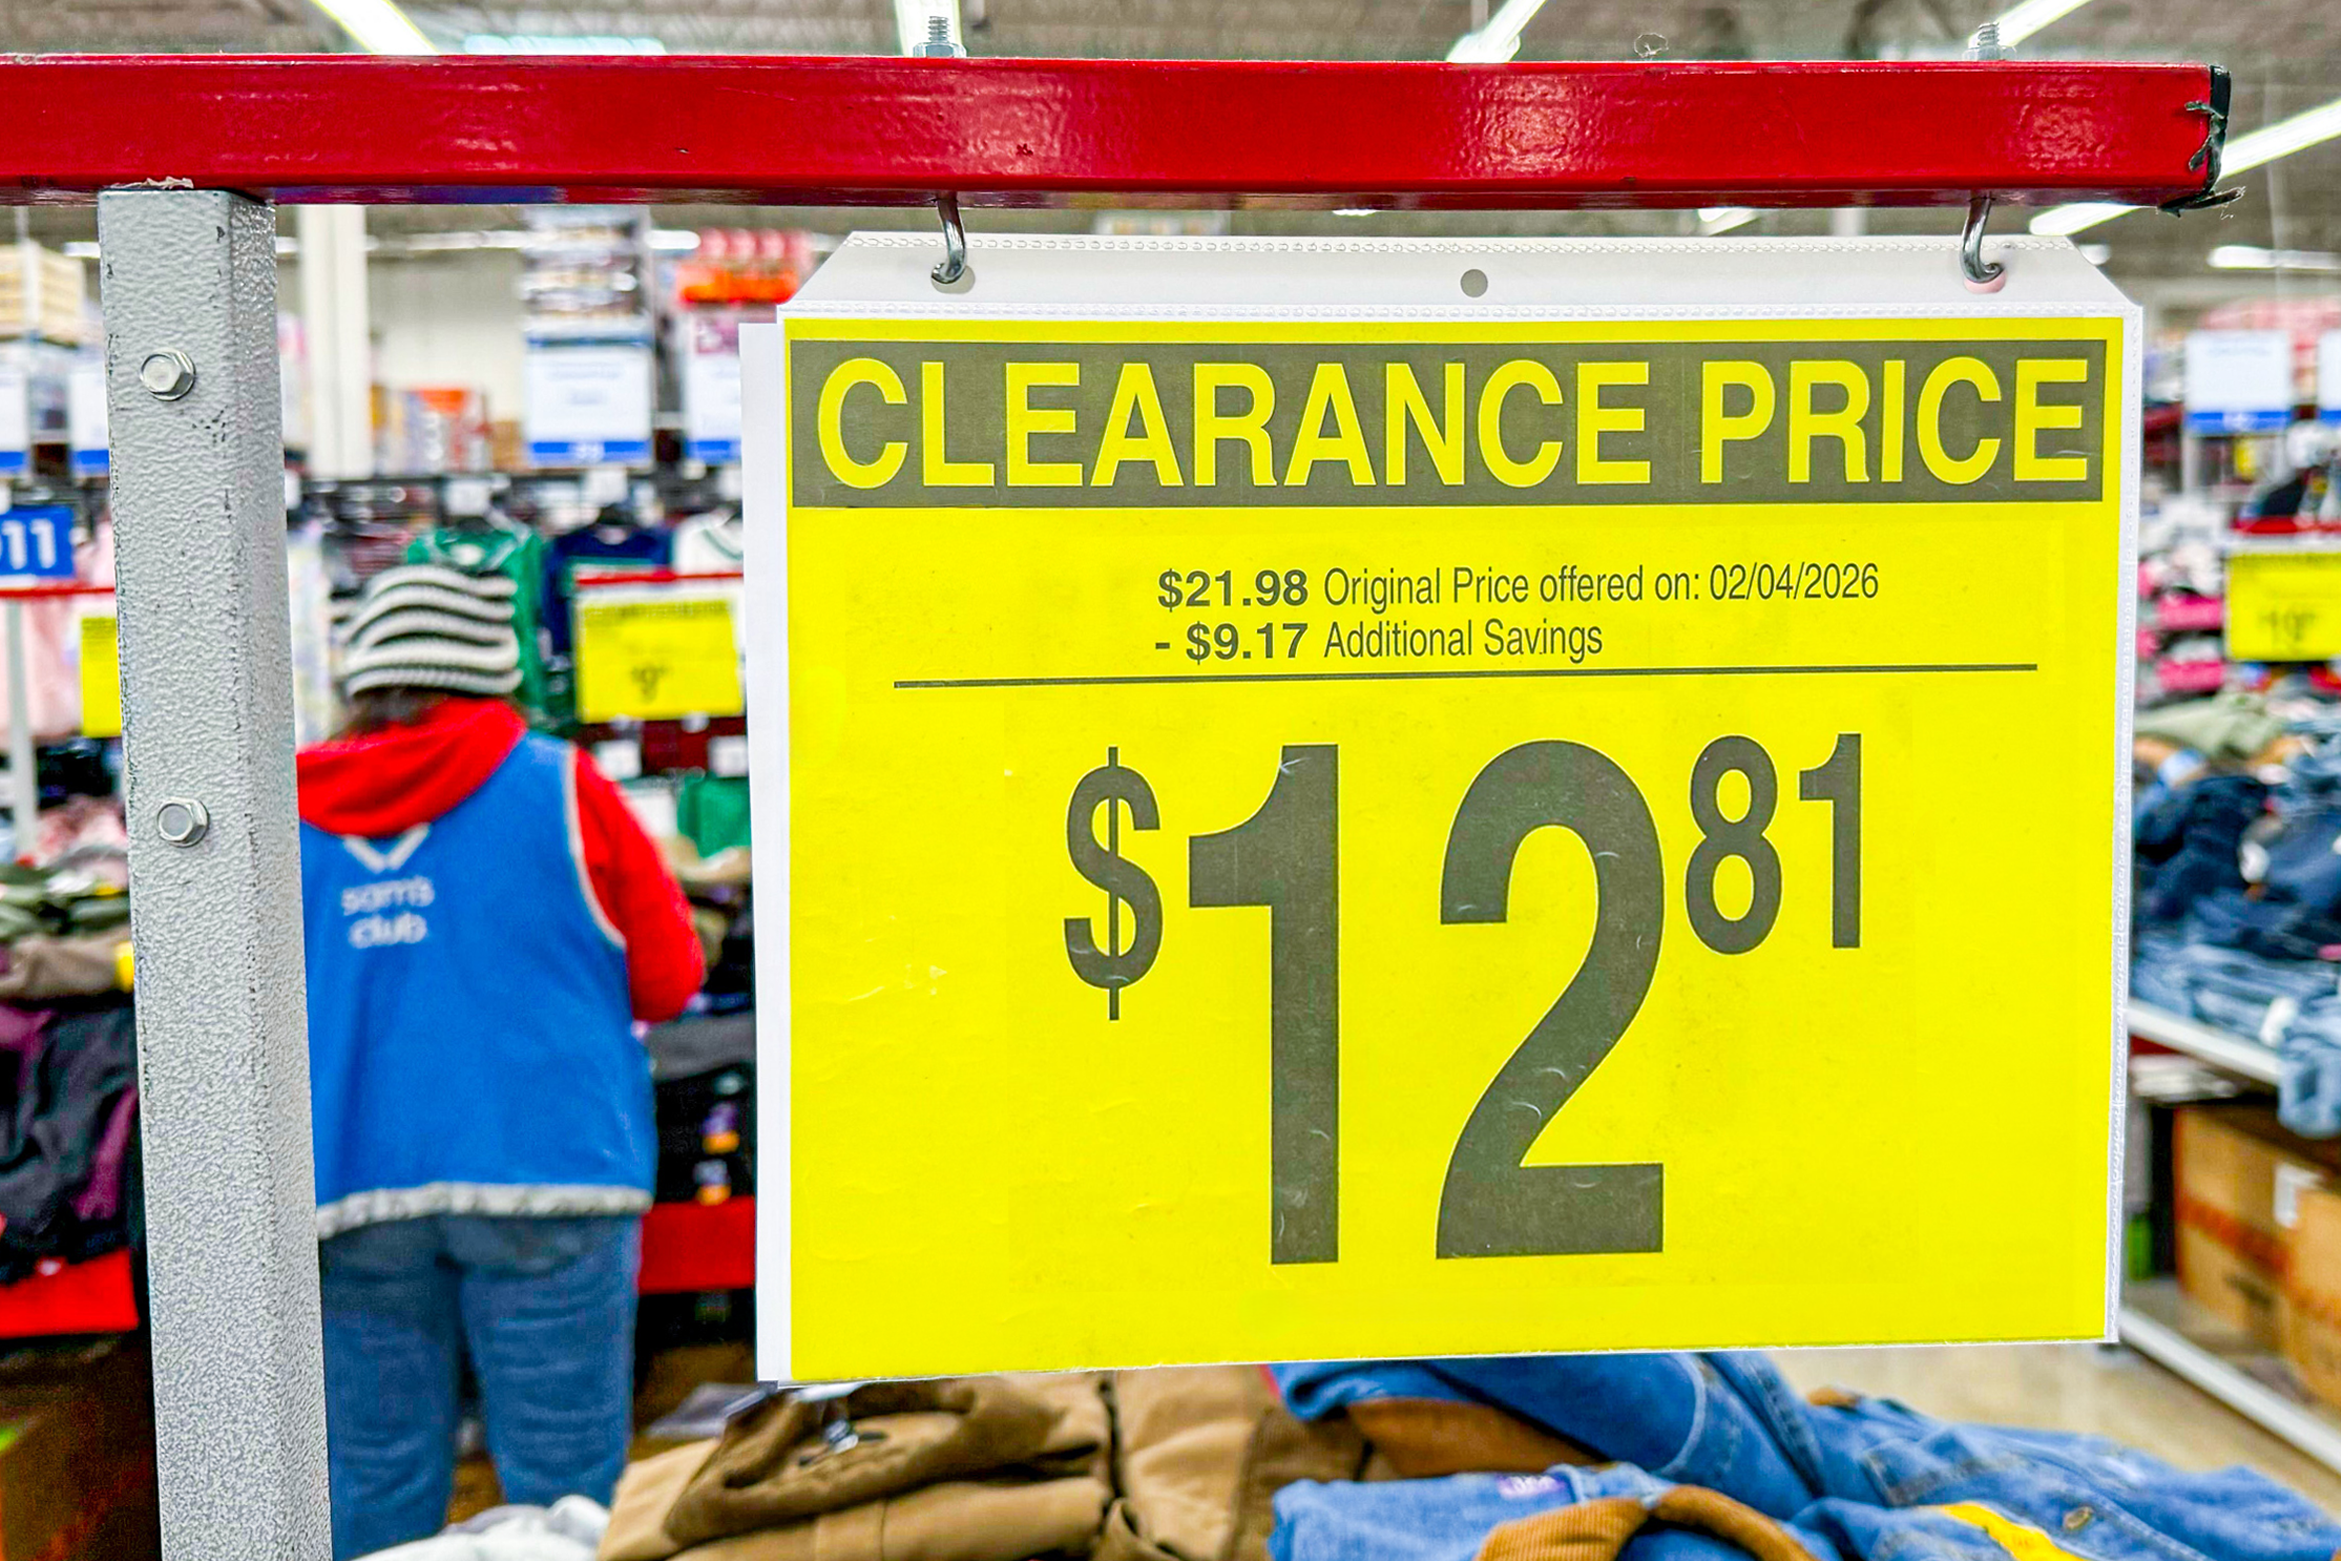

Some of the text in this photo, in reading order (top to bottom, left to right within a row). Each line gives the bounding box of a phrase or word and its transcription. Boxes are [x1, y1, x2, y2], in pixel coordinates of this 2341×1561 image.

[818, 356, 2089, 489] CLEARANCE PRICE
[0, 518, 56, 570] 11
[1158, 561, 1880, 615] $21.98 Original Price offered on: 02/04/2026
[1186, 620, 1309, 665] $9.17
[1323, 619, 1472, 658] Additional
[1484, 617, 1603, 664] Savings
[348, 911, 428, 949] club
